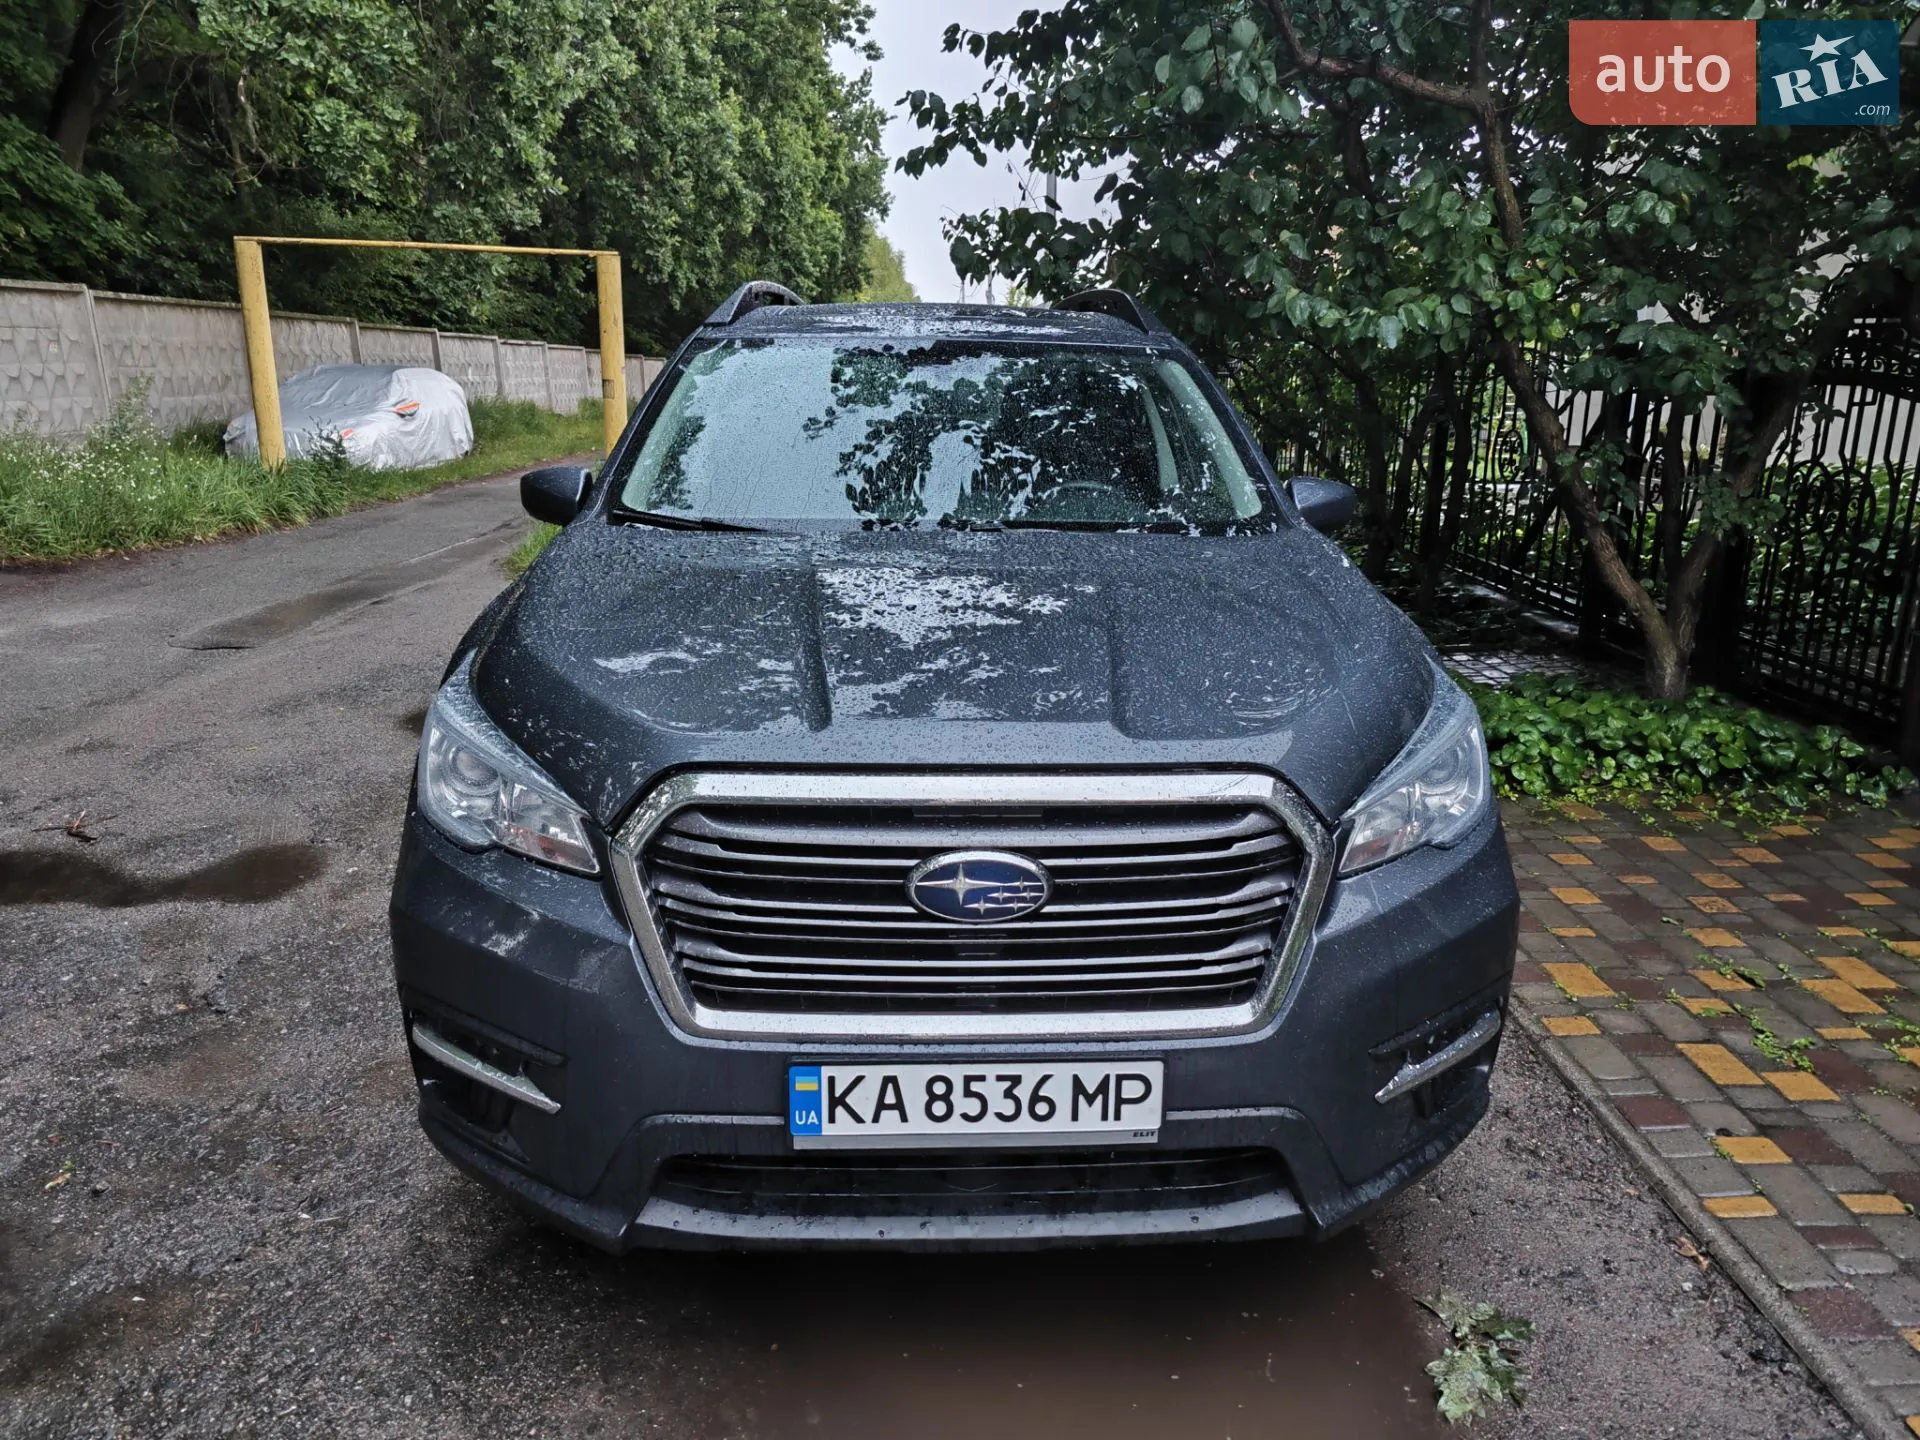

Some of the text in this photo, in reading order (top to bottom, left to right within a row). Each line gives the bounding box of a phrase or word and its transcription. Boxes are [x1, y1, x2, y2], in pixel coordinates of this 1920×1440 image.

[827, 1073, 1152, 1124] KA 8536 MP
[795, 1110, 819, 1125] UA
